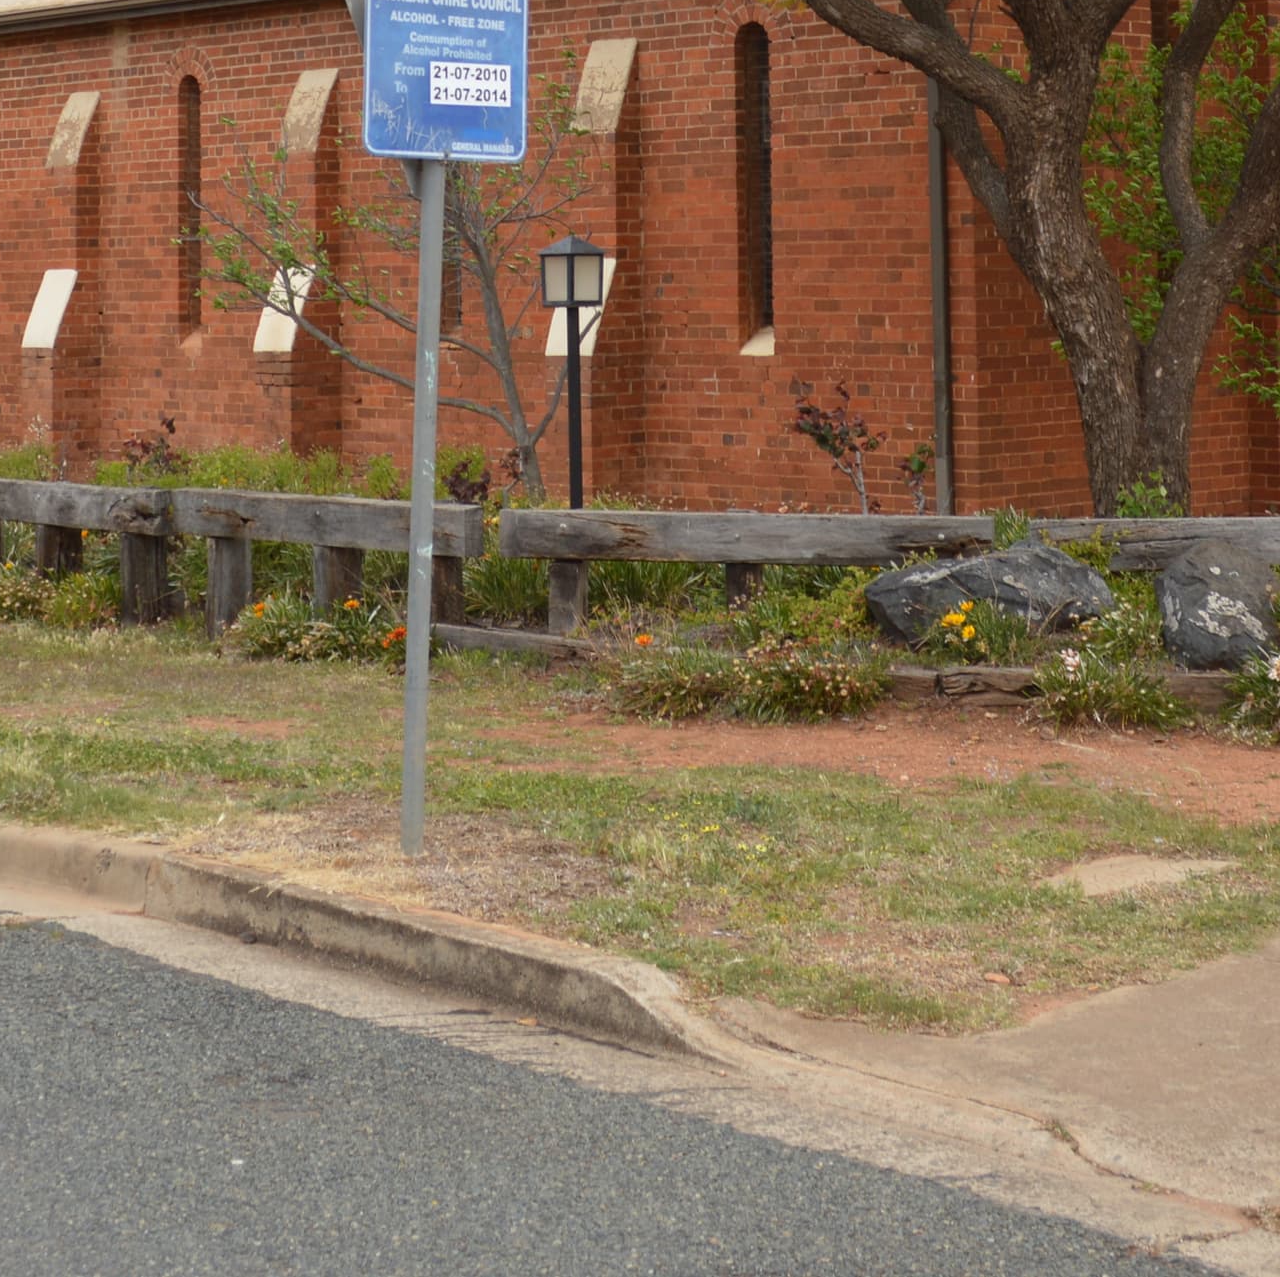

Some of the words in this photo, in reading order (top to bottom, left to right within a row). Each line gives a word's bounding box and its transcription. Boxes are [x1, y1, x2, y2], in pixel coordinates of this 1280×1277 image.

[390, 10, 439, 25] ALCOHOL
[448, 15, 475, 28] FREE
[477, 18, 505, 31] ZONE
[409, 31, 474, 47] Consumption
[477, 38, 487, 48] of
[402, 44, 440, 57] Alcohol
[443, 48, 492, 61] Prohibited
[394, 62, 425, 76] From
[433, 65, 507, 82] 21-07-2010
[394, 80, 408, 93] To
[433, 86, 507, 103] 21-07-2014
